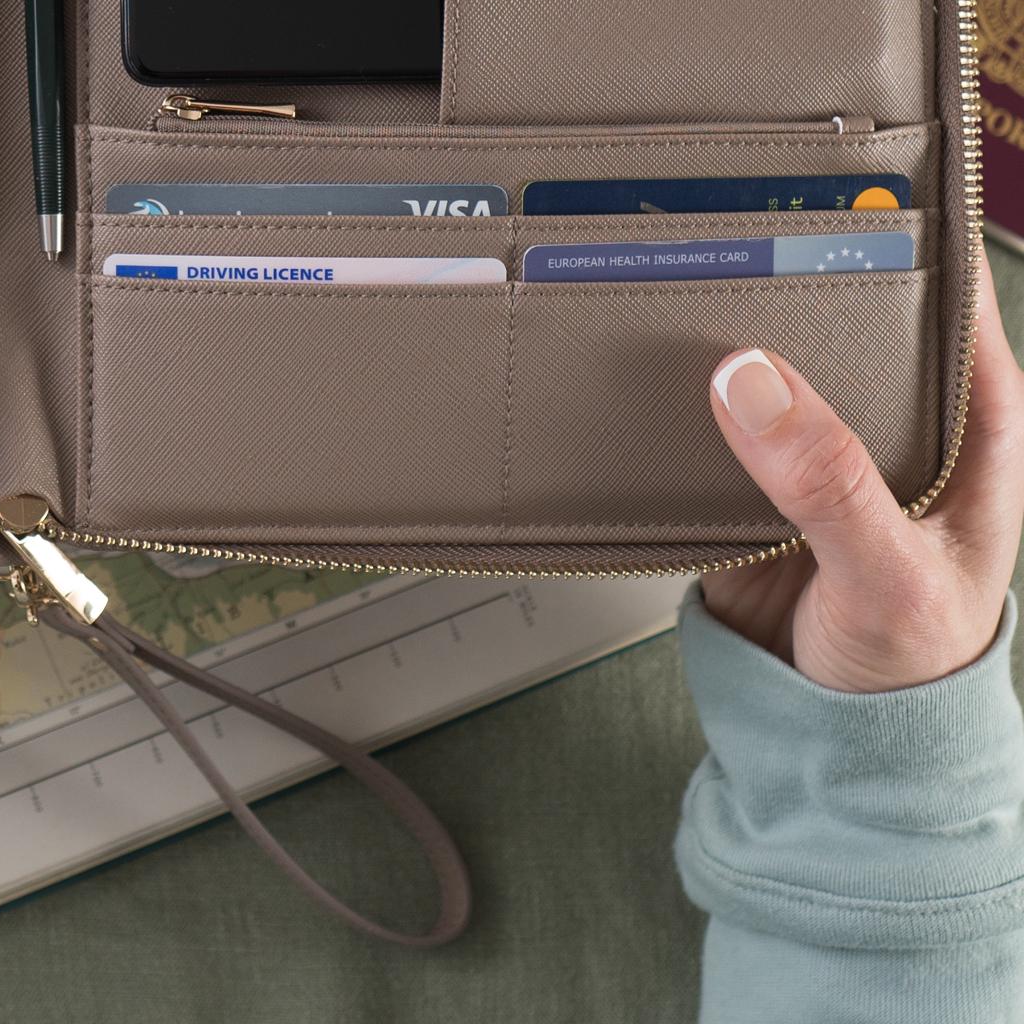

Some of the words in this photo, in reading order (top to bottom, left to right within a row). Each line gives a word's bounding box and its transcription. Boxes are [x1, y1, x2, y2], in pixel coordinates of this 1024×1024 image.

[548, 256, 606, 269] EUROPEAN
[609, 255, 650, 268] HEALTH
[653, 253, 716, 266] INSURANCE
[720, 251, 750, 264] CARD
[187, 266, 259, 281] DRIVING
[263, 267, 334, 282] LICENCE
